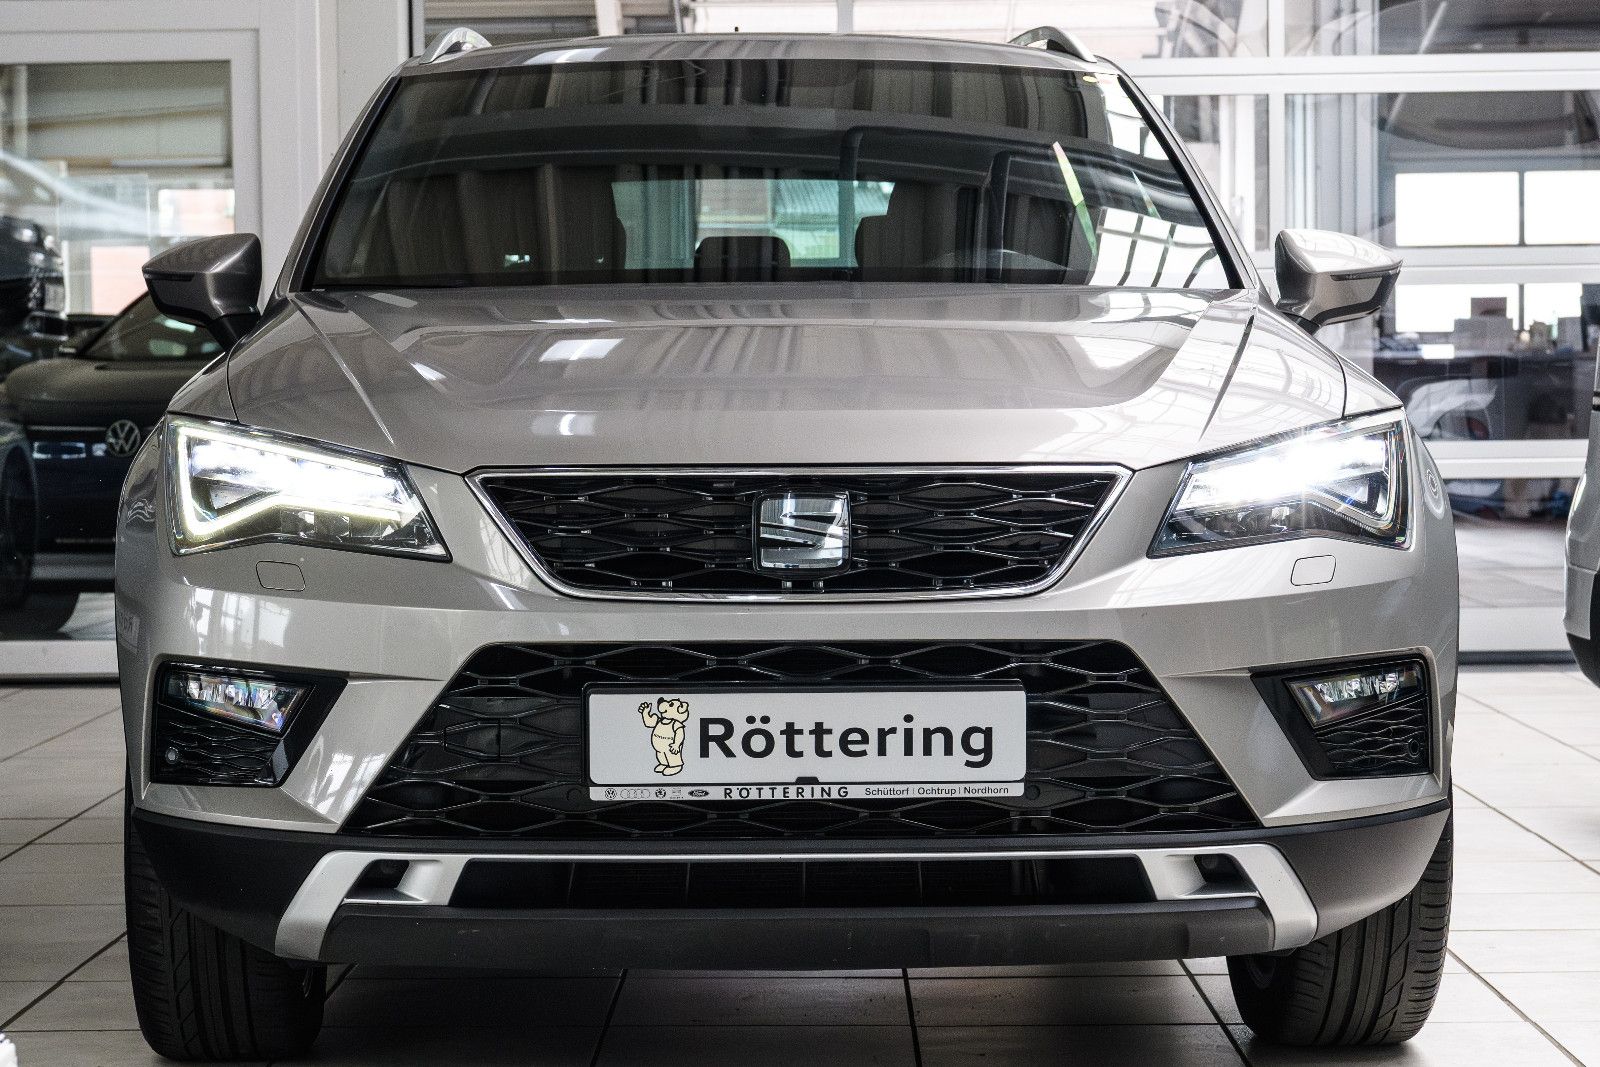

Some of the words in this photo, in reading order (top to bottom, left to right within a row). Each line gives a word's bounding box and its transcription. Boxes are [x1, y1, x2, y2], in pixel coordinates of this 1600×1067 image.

[700, 714, 993, 769] Röttering
[723, 786, 849, 799] RÖTTERING
[864, 786, 910, 797] Schüttorf
[917, 786, 957, 797] Ochtrup
[963, 785, 1009, 796] Nordhorn
